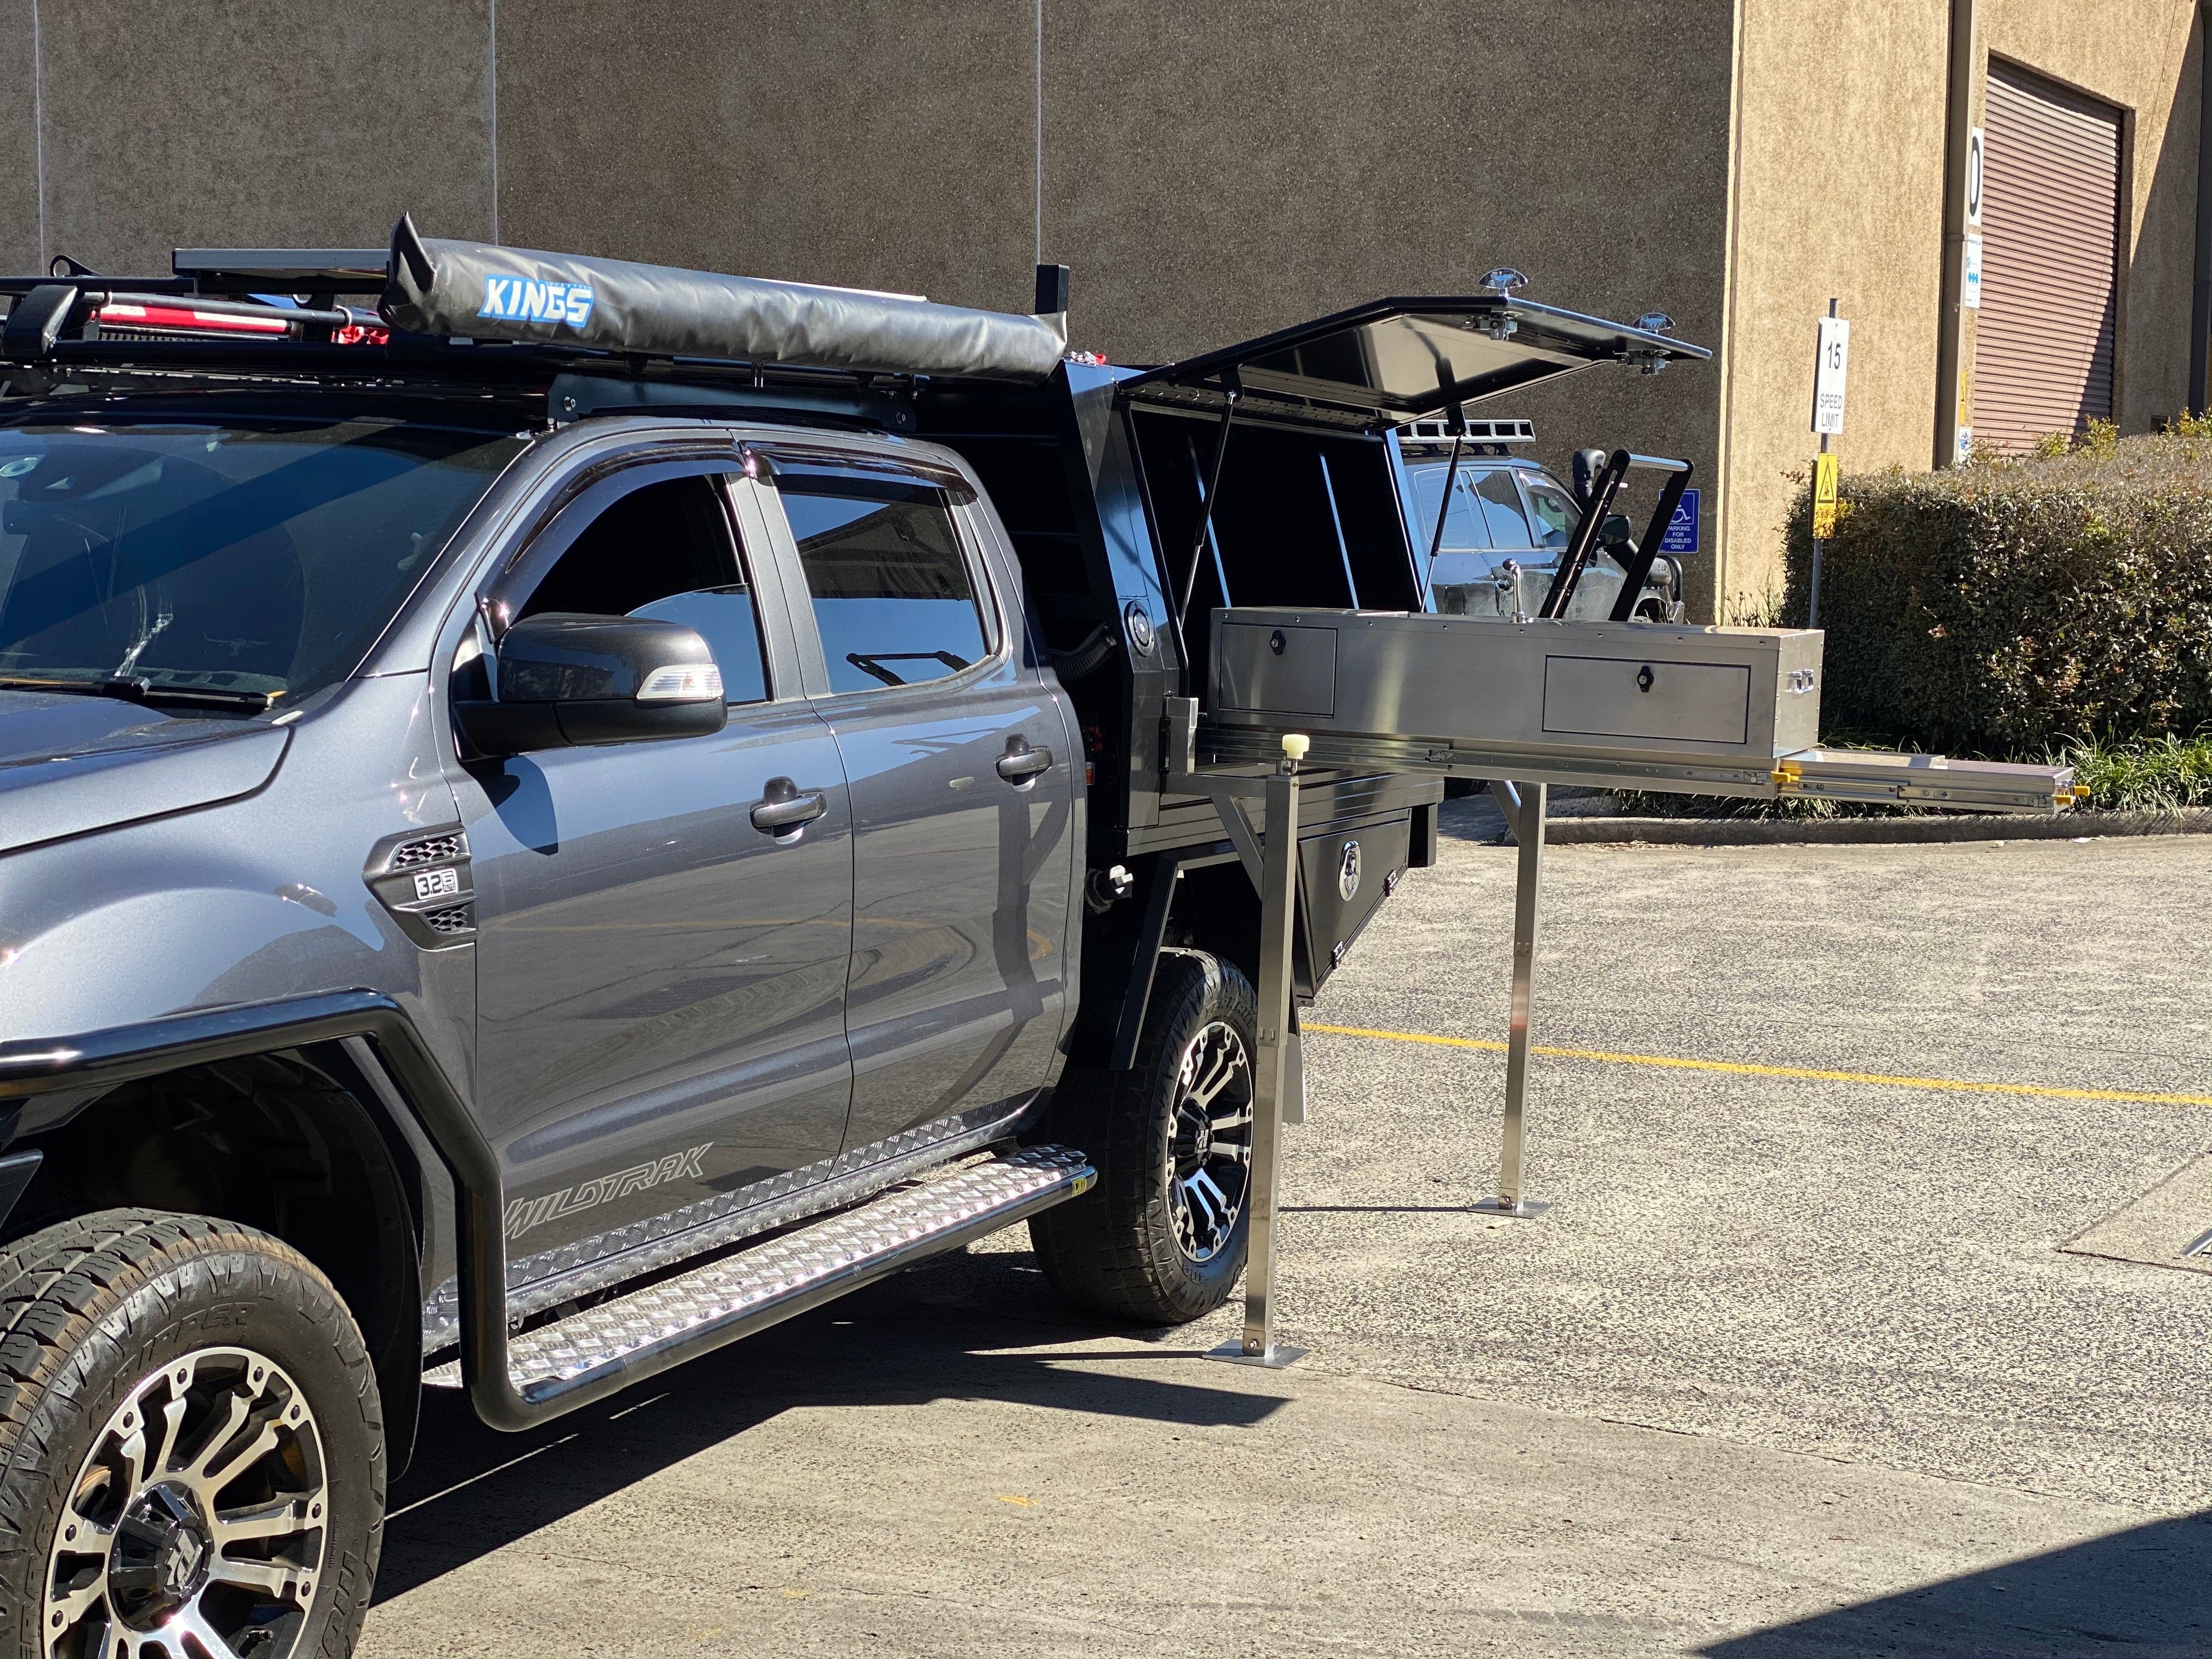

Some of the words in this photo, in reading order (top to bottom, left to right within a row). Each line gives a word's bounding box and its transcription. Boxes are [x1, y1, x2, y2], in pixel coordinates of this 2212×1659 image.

[483, 279, 592, 323] KINGS
[1827, 340, 1841, 370] 15
[1820, 393, 1842, 409] SPEED
[1821, 412, 1839, 427] LIMIT
[418, 873, 443, 897] 3.2
[443, 884, 456, 893] AUTO
[504, 1141, 714, 1240] WILDTRAK
